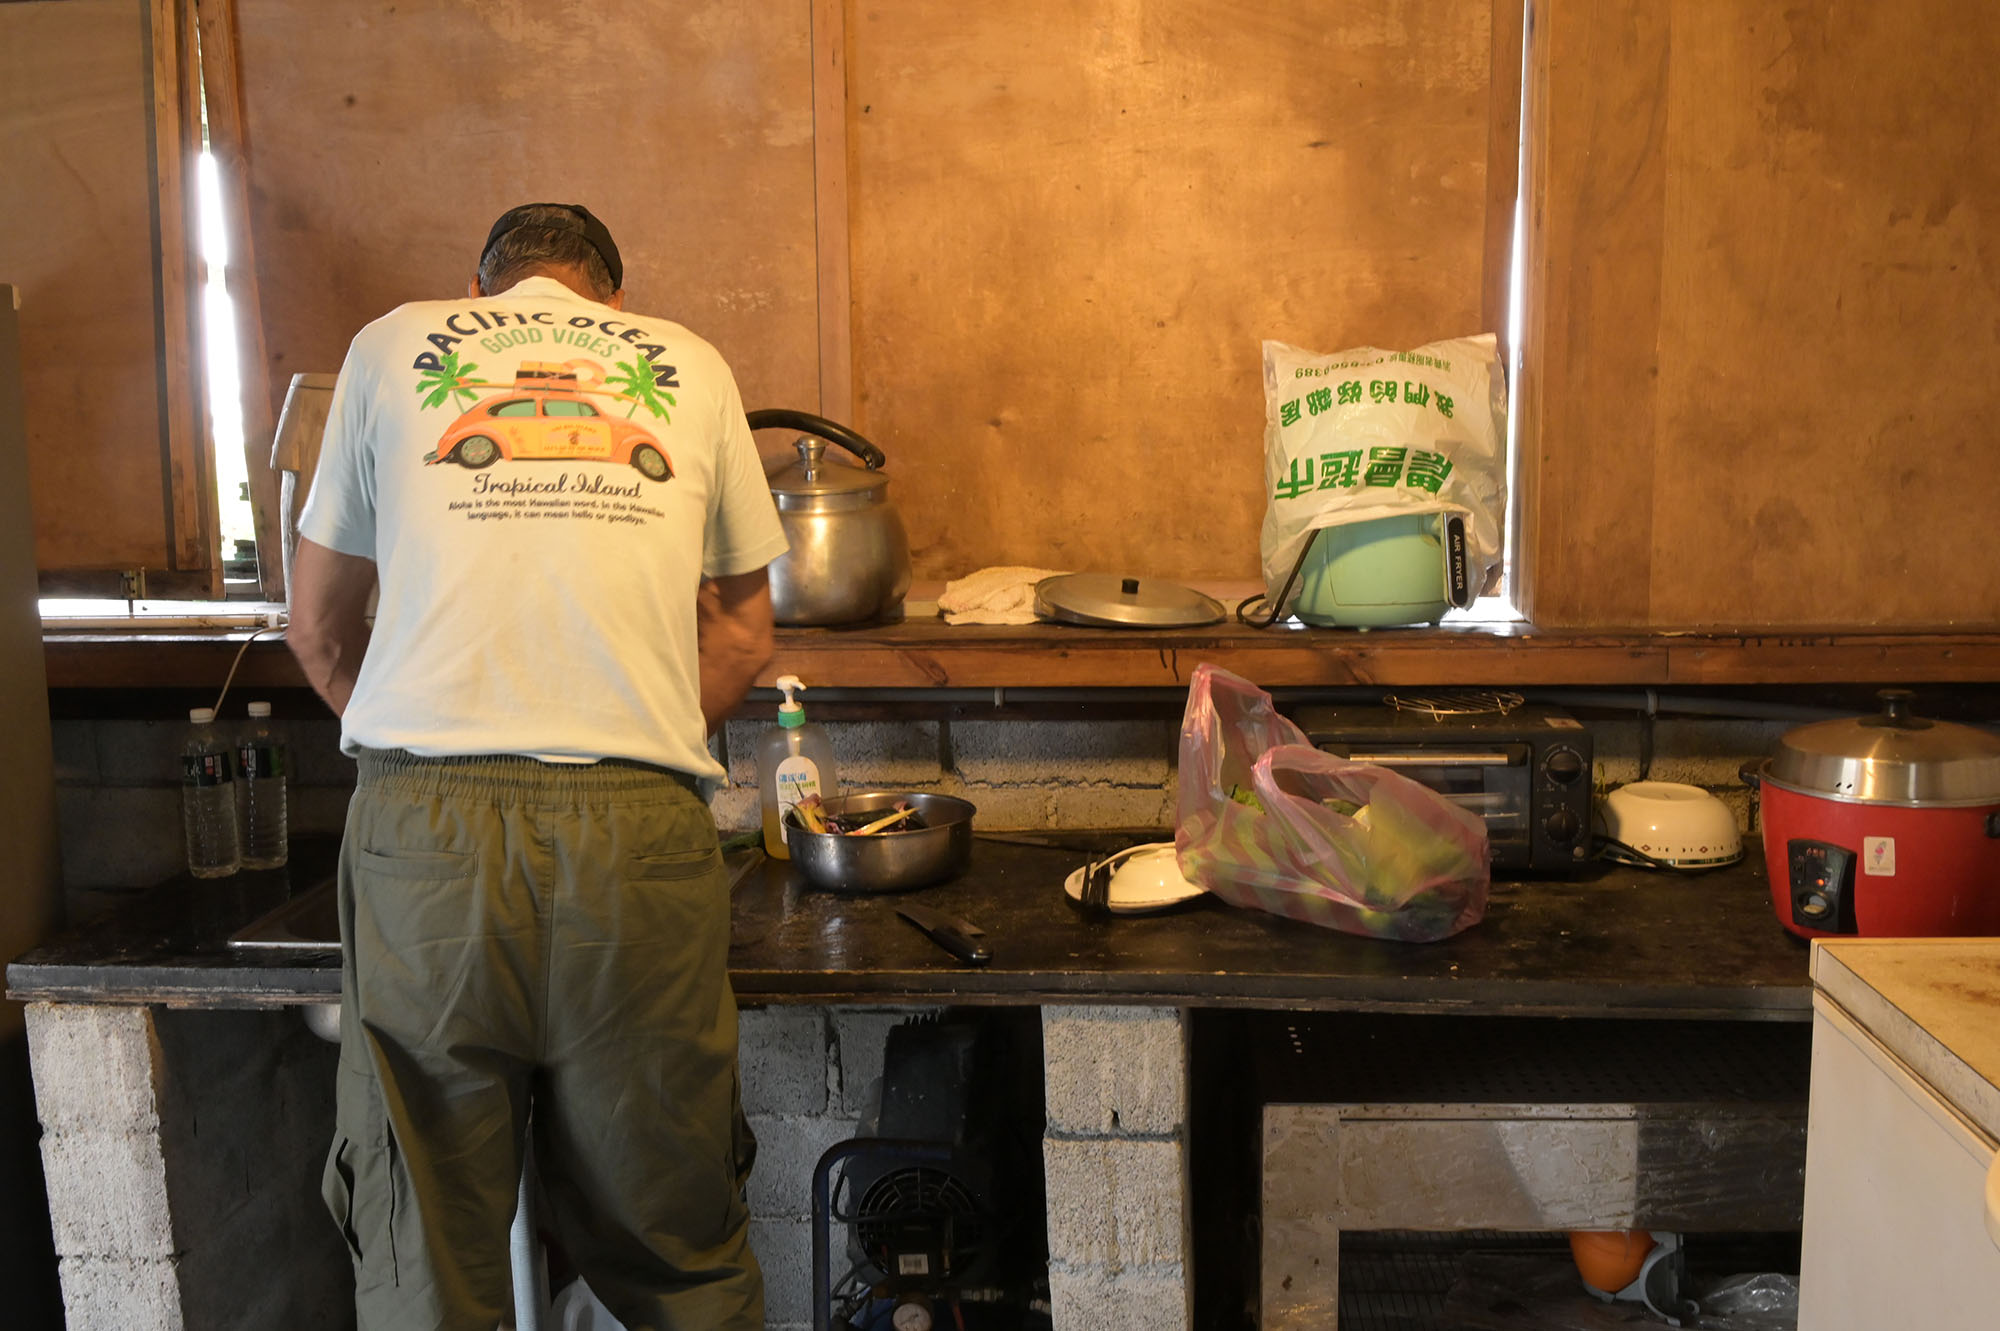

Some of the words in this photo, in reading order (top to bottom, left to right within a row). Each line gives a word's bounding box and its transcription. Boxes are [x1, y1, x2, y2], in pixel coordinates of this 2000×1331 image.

[413, 311, 555, 371] PACIFIC
[567, 316, 680, 388] OCEAN
[480, 327, 543, 354] GOOD
[552, 328, 621, 358] VIBES
[1280, 380, 1454, 427] 我們的好鄰居
[472, 472, 569, 497] Tropical
[571, 474, 642, 498] Island
[1274, 446, 1453, 500] 農會超市
[449, 501, 473, 511] Aloha
[475, 499, 483, 508] is
[485, 499, 500, 507] the
[503, 499, 527, 507] most
[529, 498, 571, 508] Hawaiian
[612, 501, 627, 511] the
[629, 503, 665, 519] Hawaiian
[467, 511, 513, 521] language,
[514, 510, 521, 518] it
[543, 511, 569, 519] mean
[571, 510, 593, 520] hello
[608, 513, 648, 526] goodbye.
[1453, 534, 1461, 552] AIR
[1455, 555, 1464, 590] FRYER
